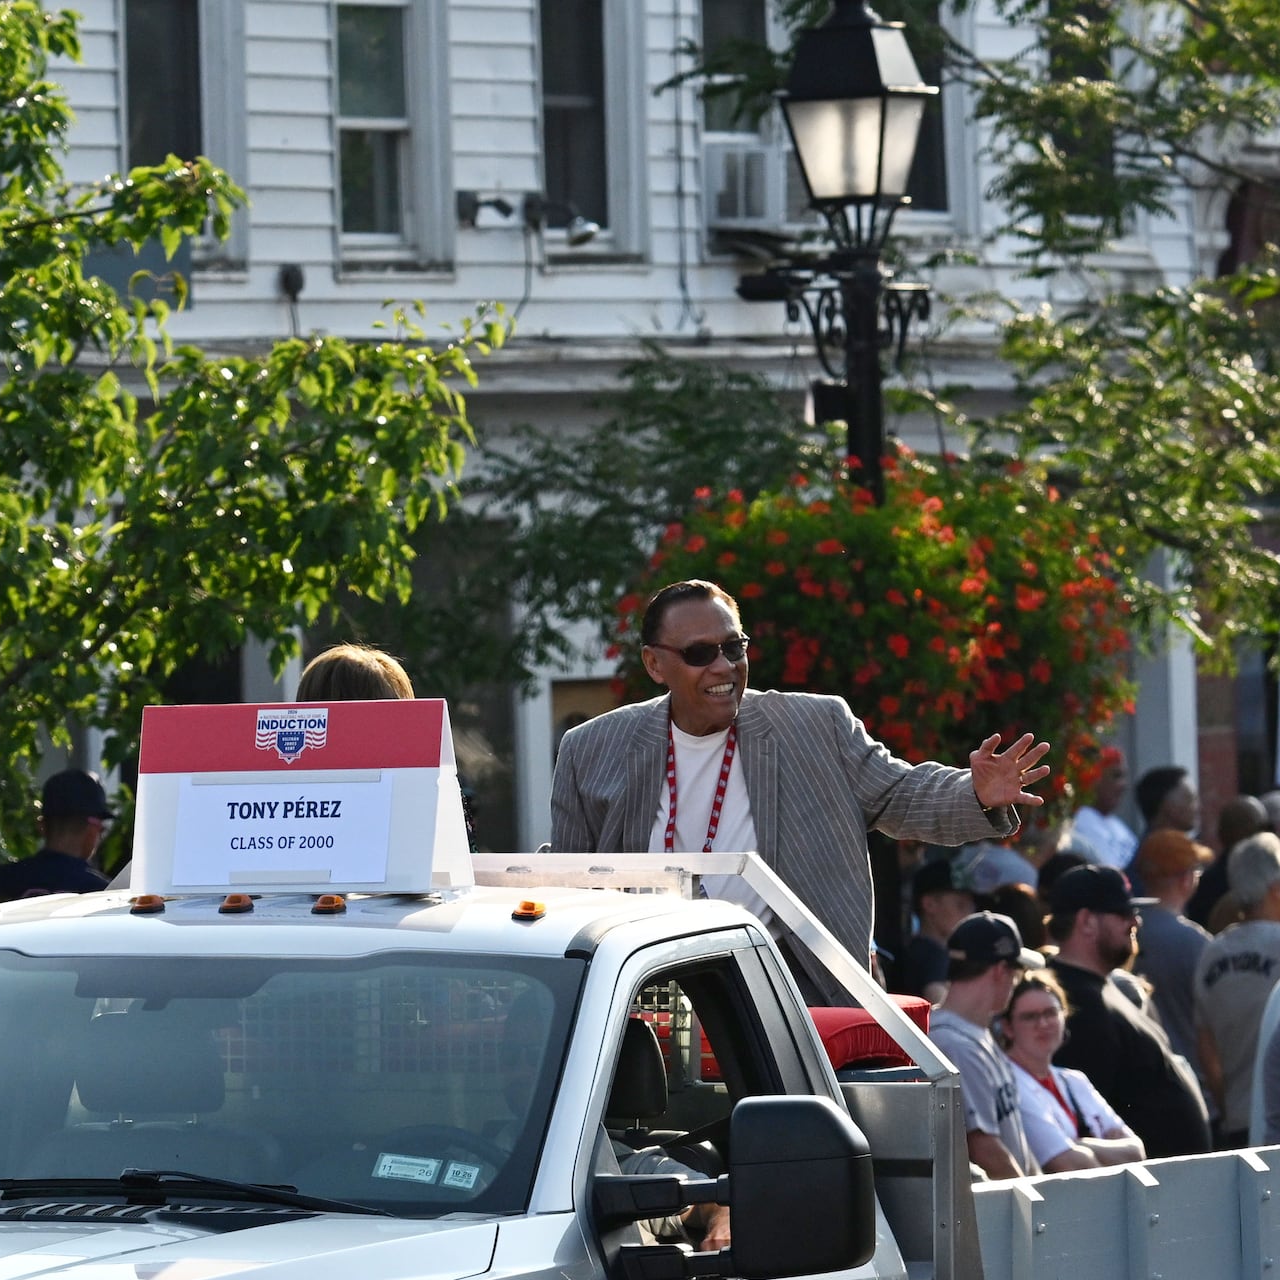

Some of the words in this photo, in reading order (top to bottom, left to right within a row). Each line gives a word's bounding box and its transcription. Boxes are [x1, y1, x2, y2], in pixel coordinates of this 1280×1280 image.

[257, 718, 327, 730] INDUCTION
[227, 801, 279, 820] TONY
[282, 795, 342, 819] PÉREZ
[230, 836, 274, 850] CLASS
[277, 836, 296, 849] OF
[299, 835, 334, 849] 2000
